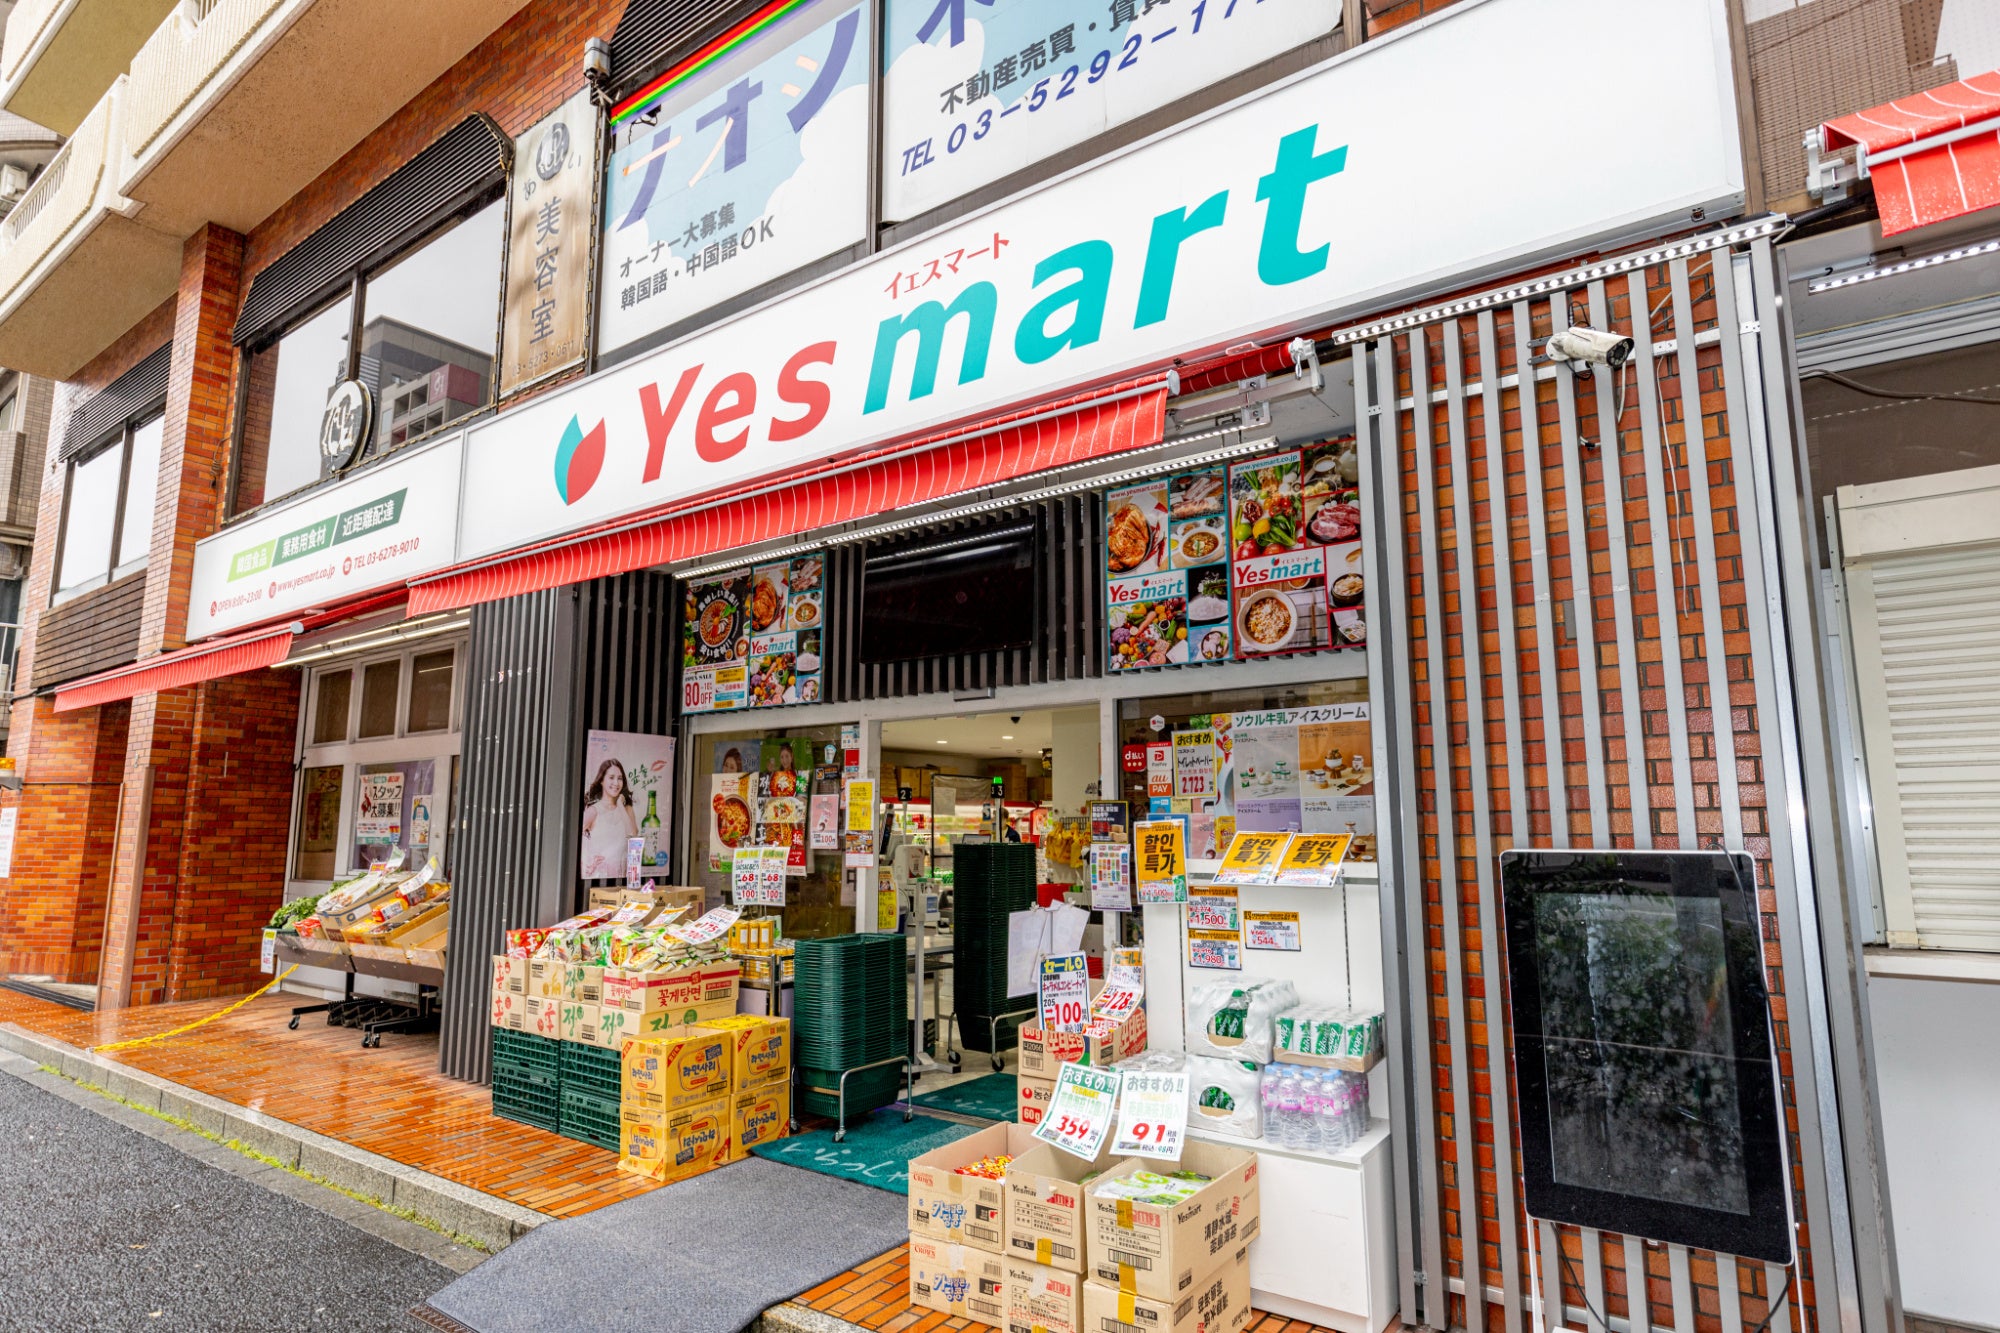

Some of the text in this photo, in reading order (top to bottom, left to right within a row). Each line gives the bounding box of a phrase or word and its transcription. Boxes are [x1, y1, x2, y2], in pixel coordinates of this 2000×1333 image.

[902, 138, 935, 177] TEL
[619, 202, 736, 279] オーナー大募集
[529, 195, 562, 346] 美容室
[1233, 453, 1298, 472] www.yesmart.co.jp
[1110, 482, 1166, 498] www.yesmart.co.jp
[281, 524, 327, 559] 業務用食材
[342, 500, 395, 537] 近距離配達
[353, 537, 420, 568] TEL 03-6278-9010
[277, 565, 336, 593] www.yesmart.co.jp
[1236, 557, 1322, 587] Yesmart
[1109, 579, 1184, 603] Yesmart
[751, 638, 795, 655] Yesmart
[685, 682, 700, 707] 80
[700, 691, 713, 705] OFF
[1235, 707, 1368, 728] ソウル牛乳アイスクリーム
[1176, 732, 1212, 746] おすすめ
[1124, 750, 1145, 761] d払い
[1151, 774, 1169, 783] au
[900, 789, 907, 800] 2
[997, 785, 1003, 797] 3
[1152, 784, 1168, 793] PAY
[1144, 833, 1174, 854] 할인
[1239, 838, 1278, 851] 할인
[1297, 839, 1338, 852] 할인
[1144, 853, 1177, 876] 특가
[1233, 851, 1271, 865] 특가
[1292, 851, 1334, 866] 특가
[742, 873, 755, 882] 68
[767, 873, 779, 882] 68
[1044, 957, 1074, 974] セール
[657, 985, 701, 1008] 꽃게탕면
[1105, 991, 1134, 1011] 128
[1054, 1001, 1082, 1026] 100
[750, 1050, 777, 1064] 라면사리
[631, 1067, 654, 1081] 라면사리
[682, 1060, 716, 1078] 라면사리
[1062, 1069, 1115, 1093] おすすめ!!
[1127, 1075, 1185, 1093] おすすめ!!
[747, 1111, 778, 1131] 라면사리
[1023, 1109, 1041, 1123] 60g
[1056, 1115, 1091, 1140] 359
[1132, 1122, 1166, 1143] 91
[682, 1128, 717, 1148] 라면사리
[1177, 1204, 1202, 1225] Yesmart
